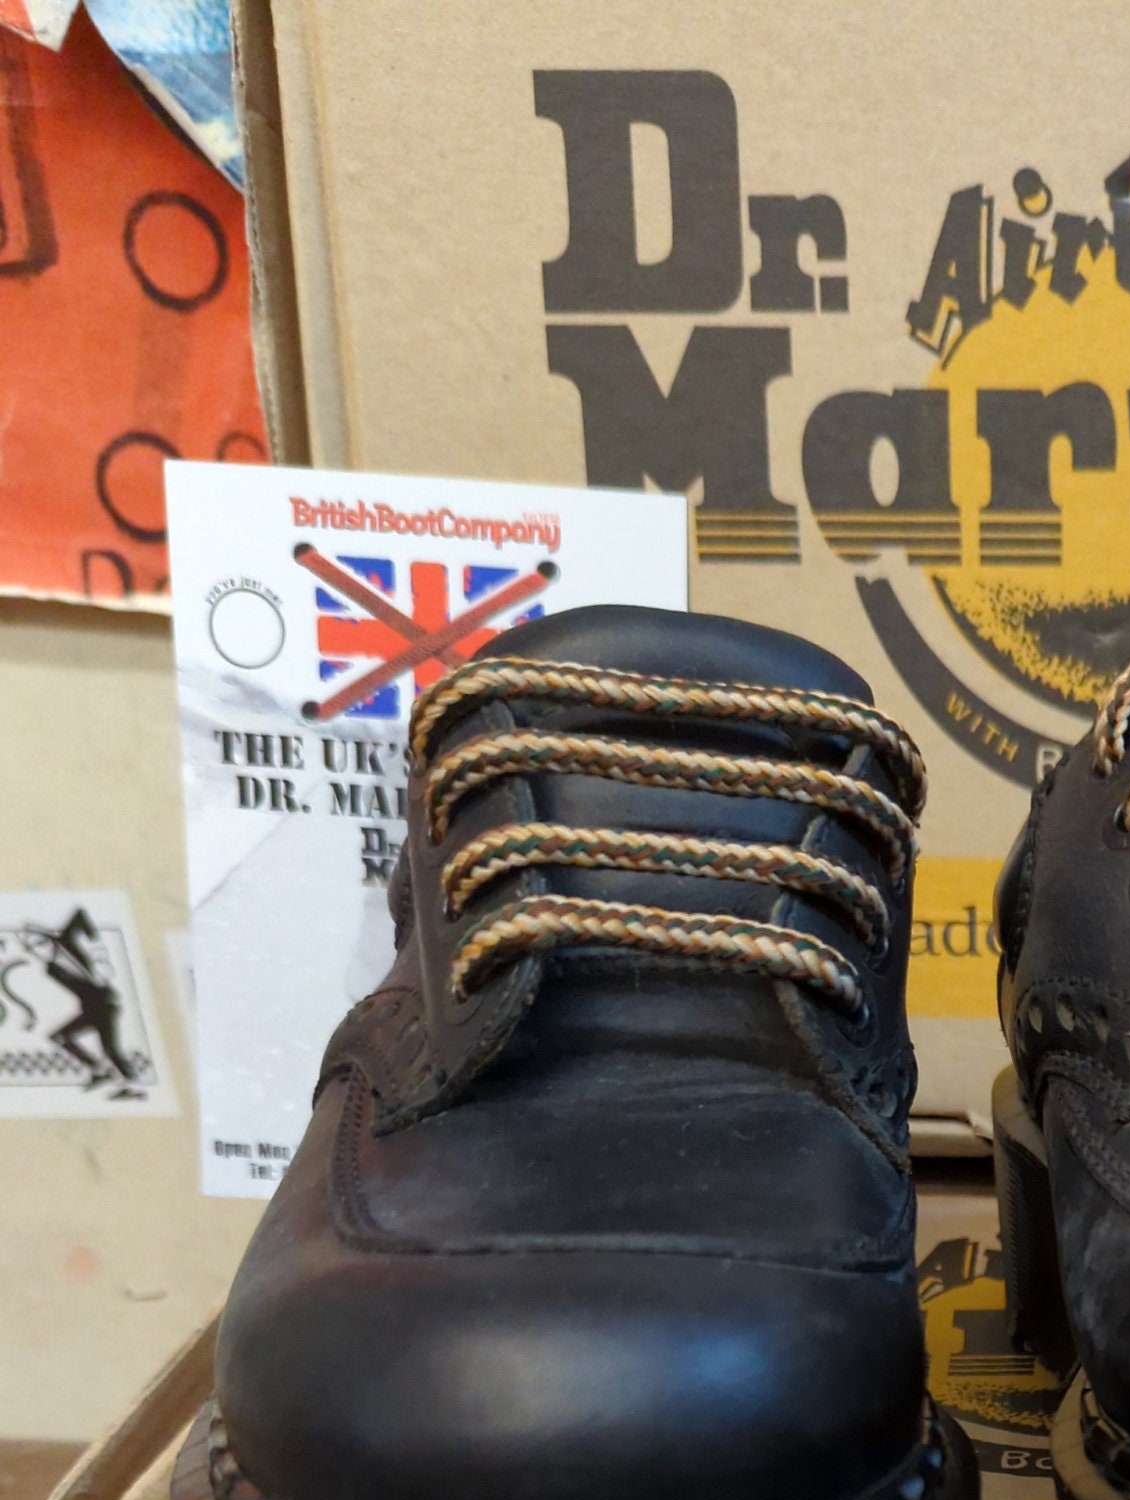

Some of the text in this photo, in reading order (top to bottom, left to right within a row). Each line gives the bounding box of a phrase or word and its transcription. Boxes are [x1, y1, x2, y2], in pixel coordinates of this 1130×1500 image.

[532, 69, 849, 315] Dr.
[214, 730, 305, 771] THE
[945, 693, 1019, 764] WITH
[236, 775, 312, 814] DR.
